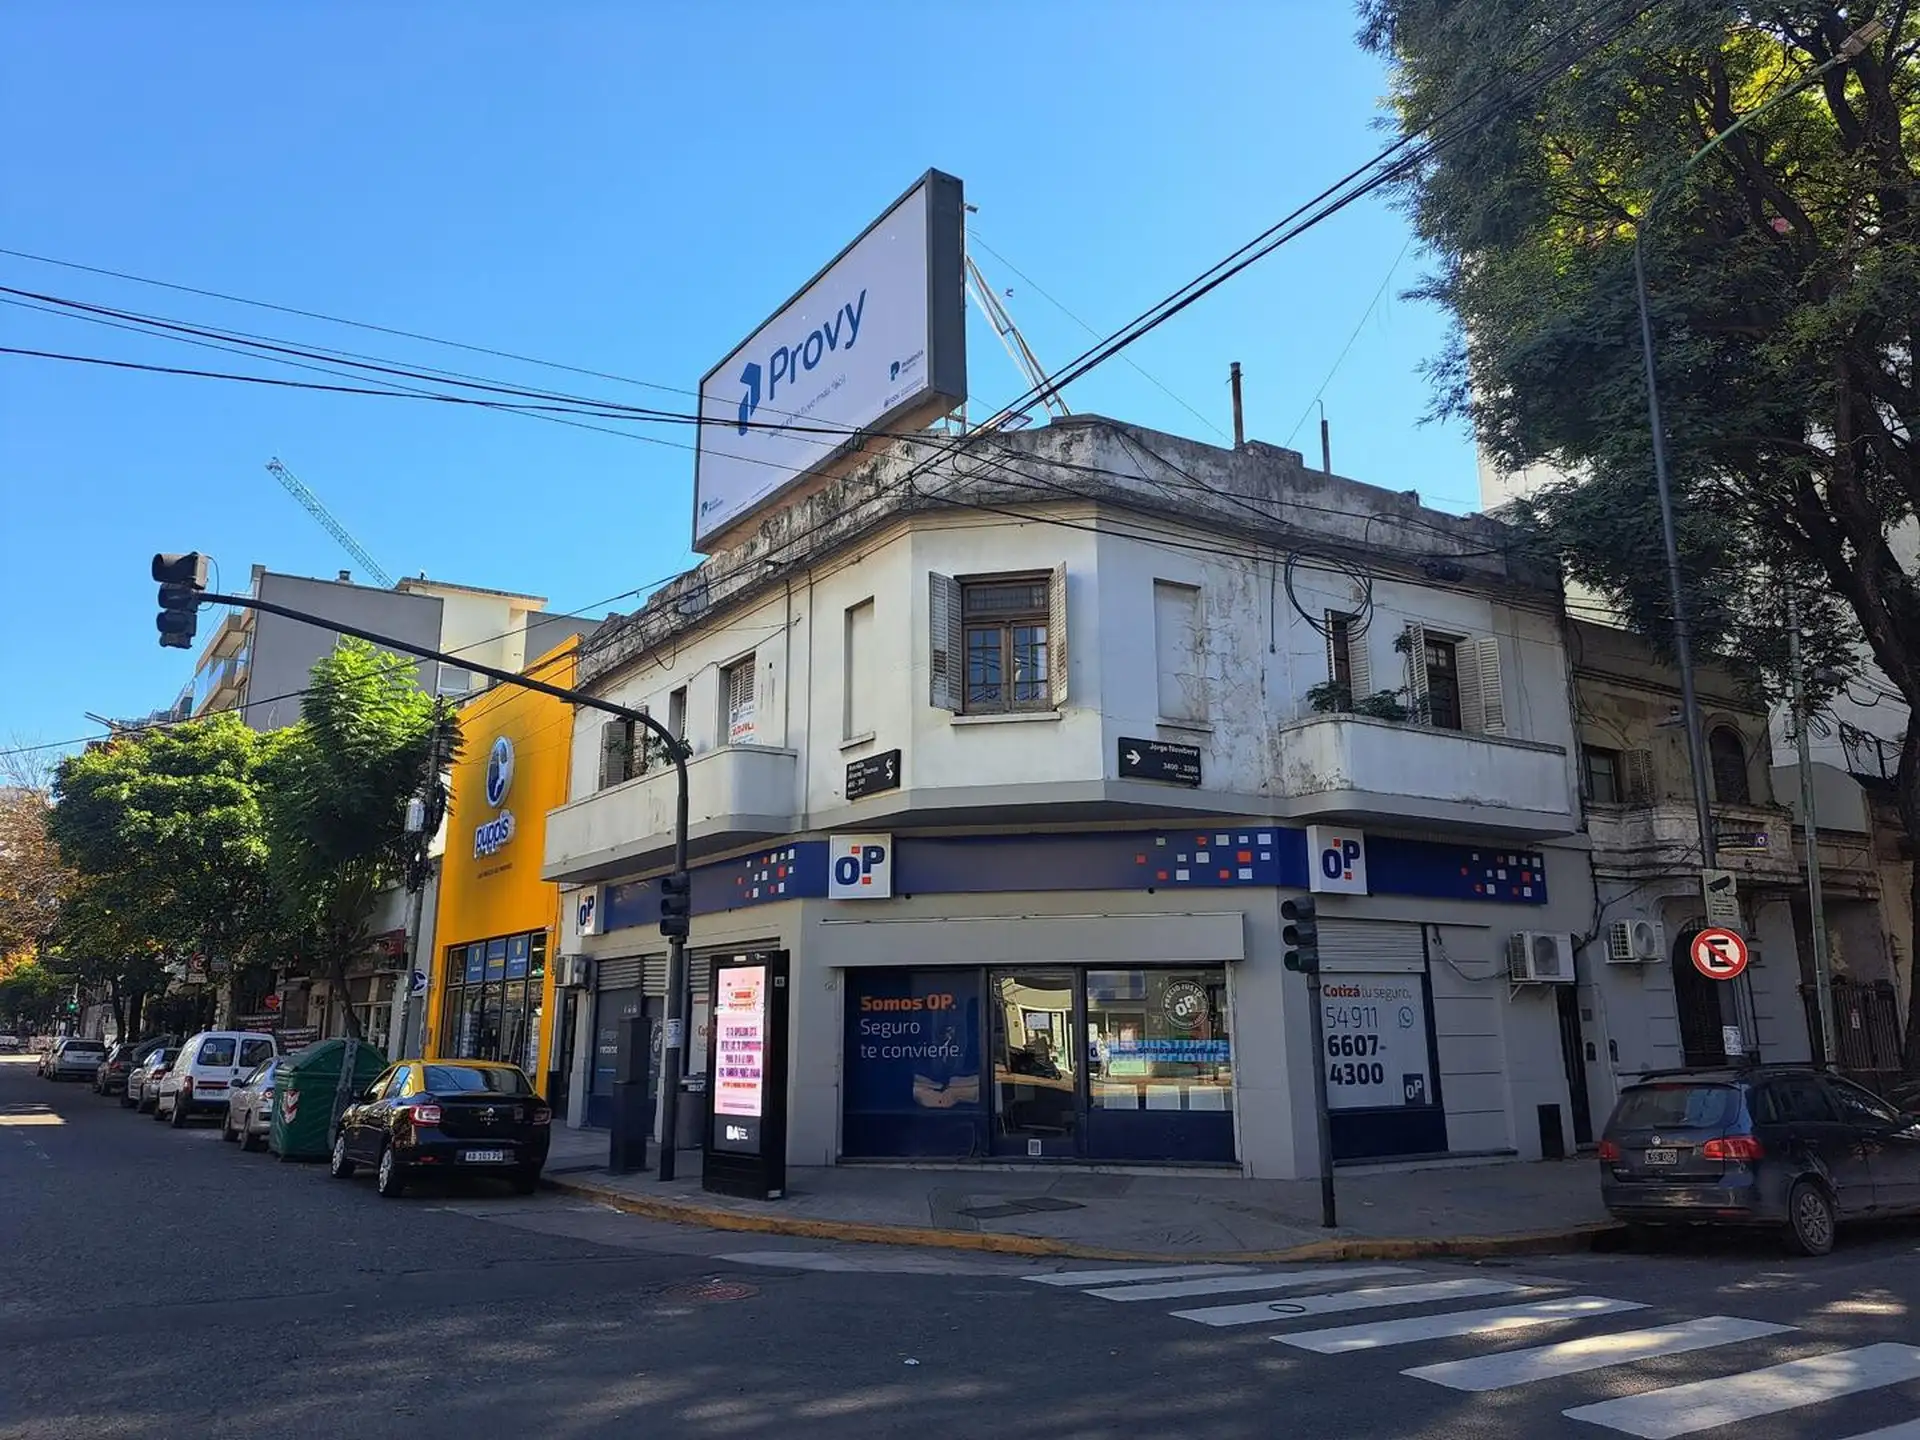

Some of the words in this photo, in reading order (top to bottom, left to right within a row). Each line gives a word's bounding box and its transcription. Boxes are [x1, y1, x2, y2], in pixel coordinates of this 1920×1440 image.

[769, 288, 868, 401] Provy
[1149, 743, 1168, 754] Jorge
[1168, 745, 1198, 757] Newbery
[834, 845, 886, 886] OP
[1322, 838, 1361, 880] OP
[579, 895, 595, 926] OP
[1323, 984, 1361, 998] Cotizá
[1361, 988, 1372, 998] tu
[861, 996, 923, 1011] Somos
[926, 994, 957, 1011] OP.
[860, 1018, 921, 1039] Seguro
[860, 1044, 877, 1059] te
[881, 1042, 963, 1059] conviene.
[1327, 1034, 1387, 1057] 6607-
[1329, 1062, 1385, 1085] 4300
[1405, 1079, 1422, 1099] OP
